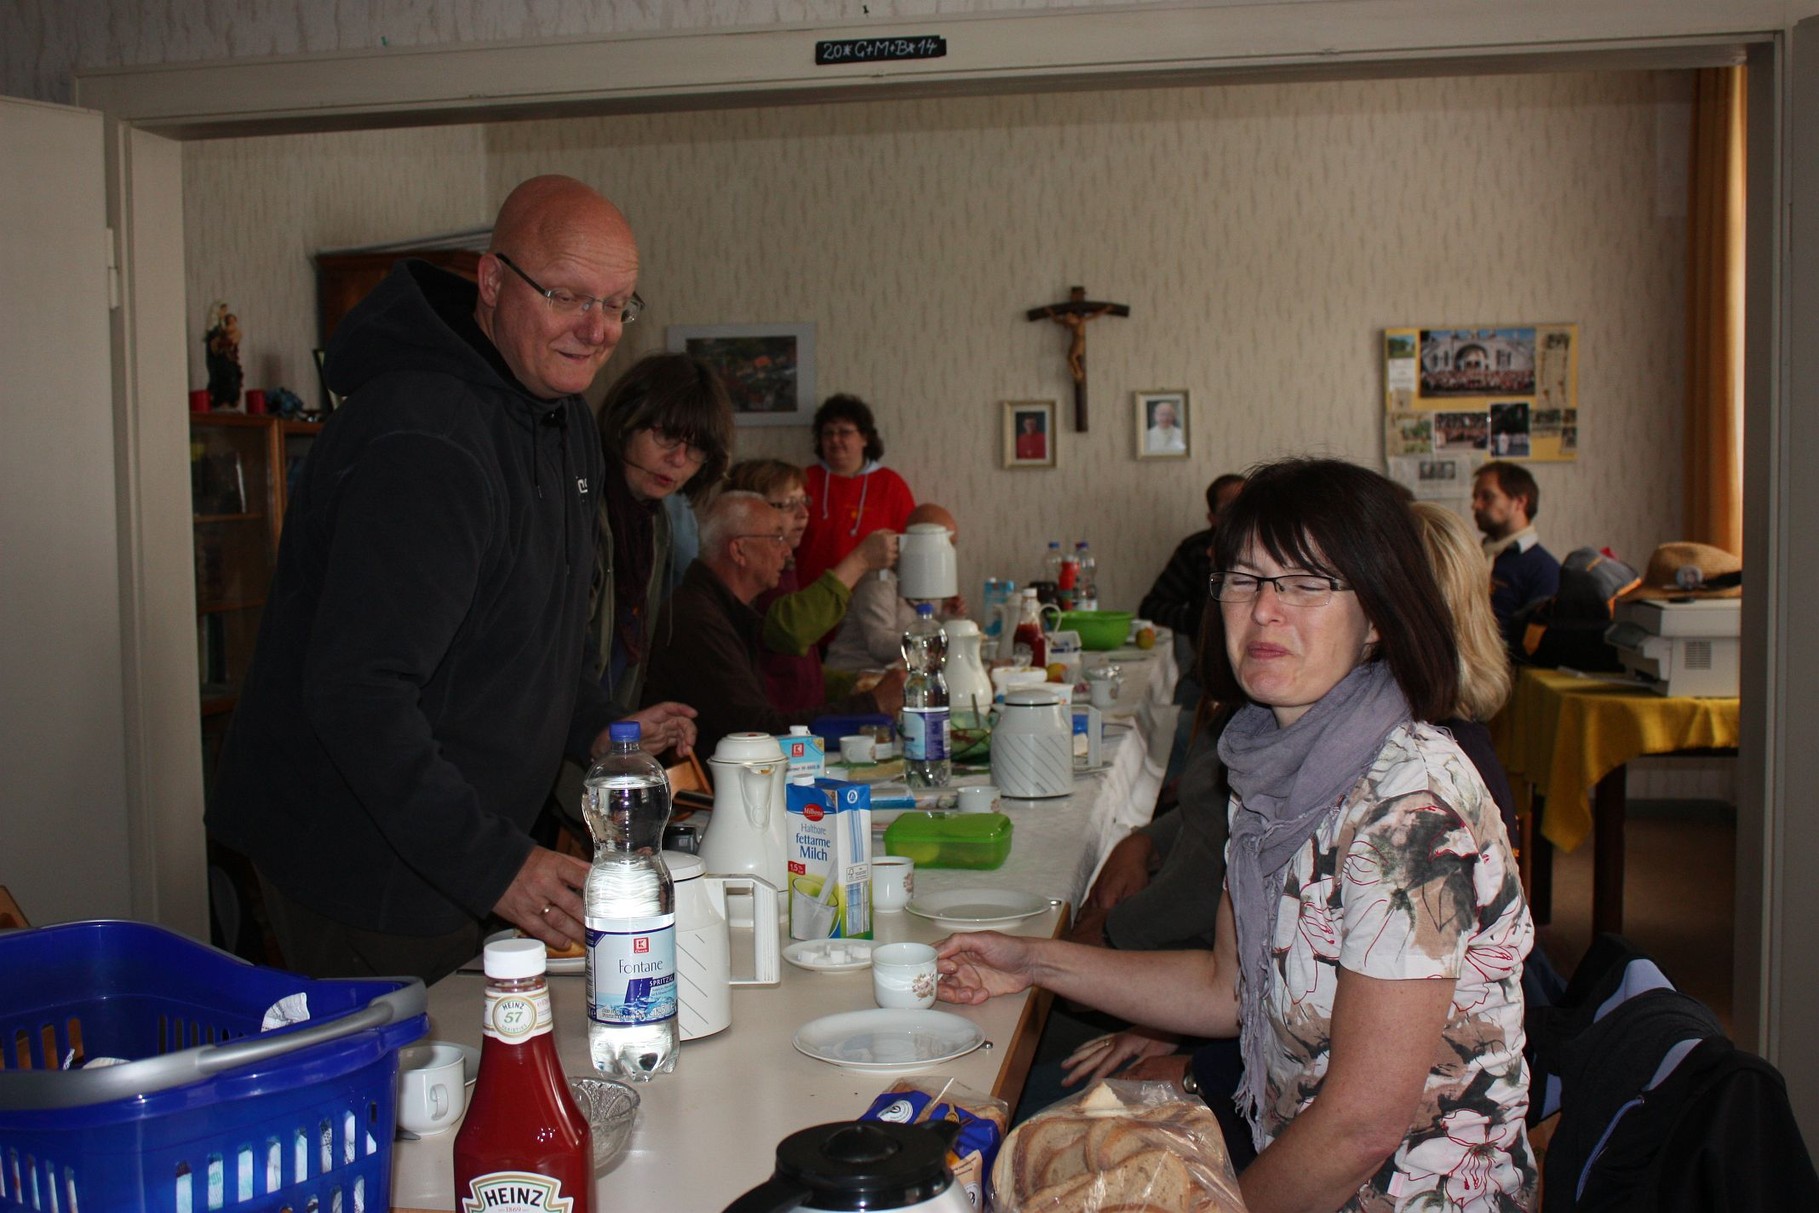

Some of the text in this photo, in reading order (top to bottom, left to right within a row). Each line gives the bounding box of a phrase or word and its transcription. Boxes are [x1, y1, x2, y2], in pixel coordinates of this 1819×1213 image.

[800, 823, 827, 835] Haltbare
[795, 832, 832, 848] fettarme
[799, 845, 828, 861] Milch
[619, 959, 664, 974] Fontane
[649, 975, 674, 987] SPRITZIG
[502, 1001, 525, 1011] HEINZ
[504, 1011, 523, 1023] 57
[484, 1187, 544, 1207] HEINZ
